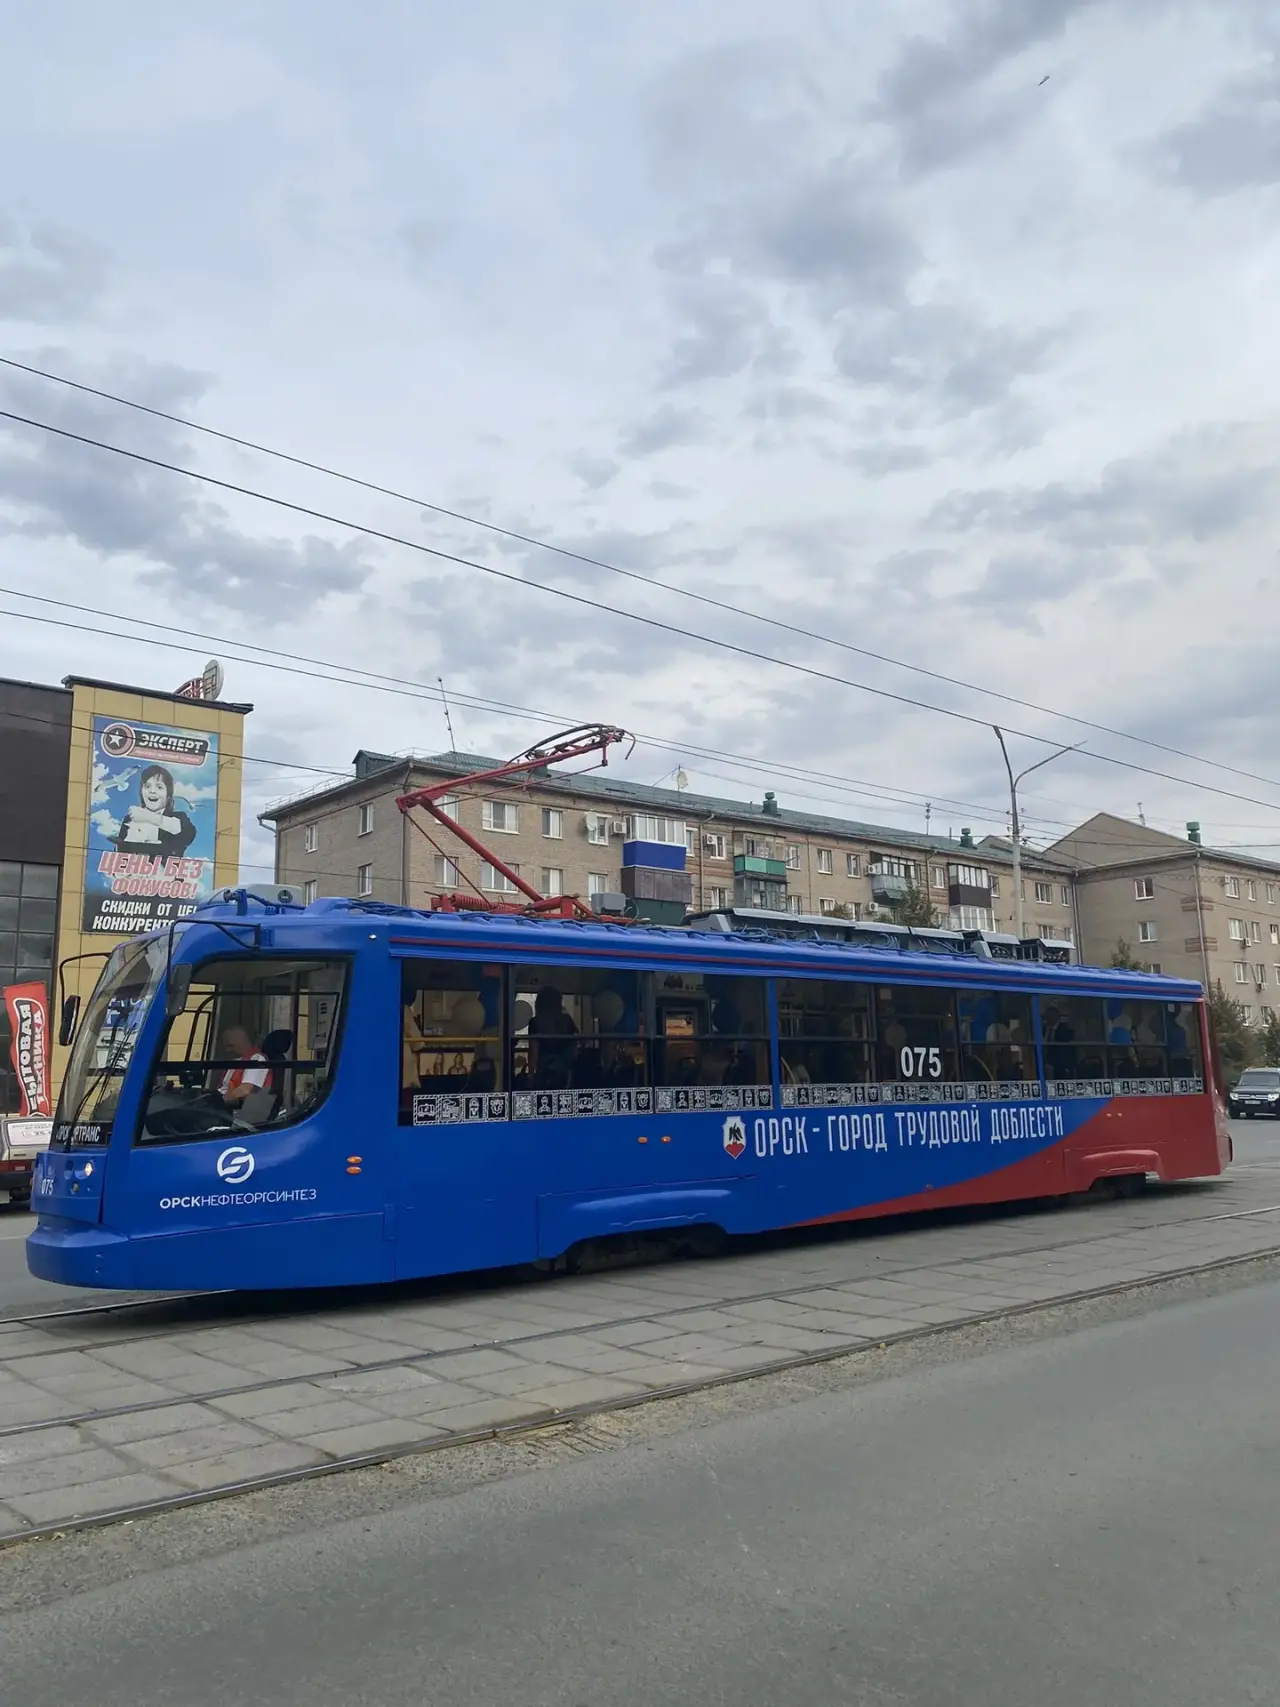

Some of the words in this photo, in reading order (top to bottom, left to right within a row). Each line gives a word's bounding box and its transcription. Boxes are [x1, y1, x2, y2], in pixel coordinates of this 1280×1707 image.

[138, 733, 203, 753] ЭКСПЕРТ
[98, 851, 162, 876] ЦЕНЫ
[164, 857, 203, 879] БЕЗ
[112, 878, 198, 899] ФОКУСОВ!
[101, 900, 151, 916] СКИДКИ
[157, 903, 172, 916] ОТ
[20, 1004, 37, 1110] БЫТОВАЯ
[33, 1010, 44, 1104] ТЕХНИКА
[901, 1047, 942, 1077] 075
[754, 1116, 808, 1157] ОРСК
[828, 1112, 888, 1153] ГОРОД
[895, 1105, 981, 1149] ТРУДОВОЙ
[990, 1105, 1064, 1144] ДОБЛЕСТИ
[41, 1178, 54, 1195] 075
[159, 1188, 317, 1209] ОРСКНЕФТЕОРГСИНТЕЗ
